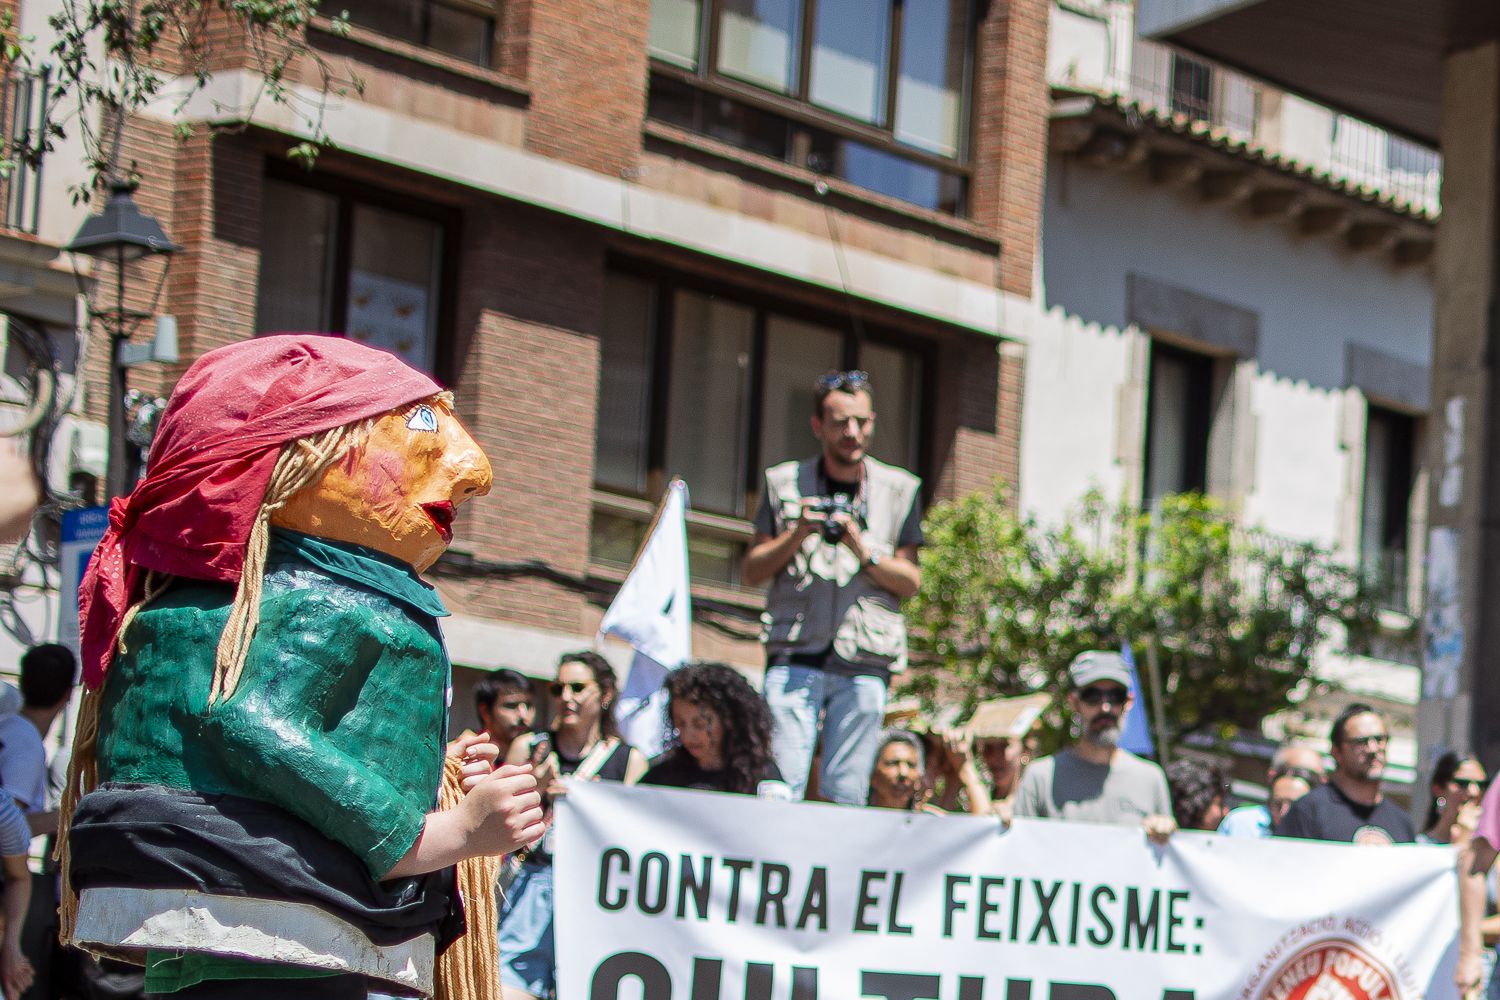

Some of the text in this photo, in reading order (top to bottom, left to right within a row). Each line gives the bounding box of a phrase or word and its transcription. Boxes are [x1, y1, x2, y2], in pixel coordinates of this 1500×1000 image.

[597, 847, 1203, 954] CONTRA EL FEIXISME:
